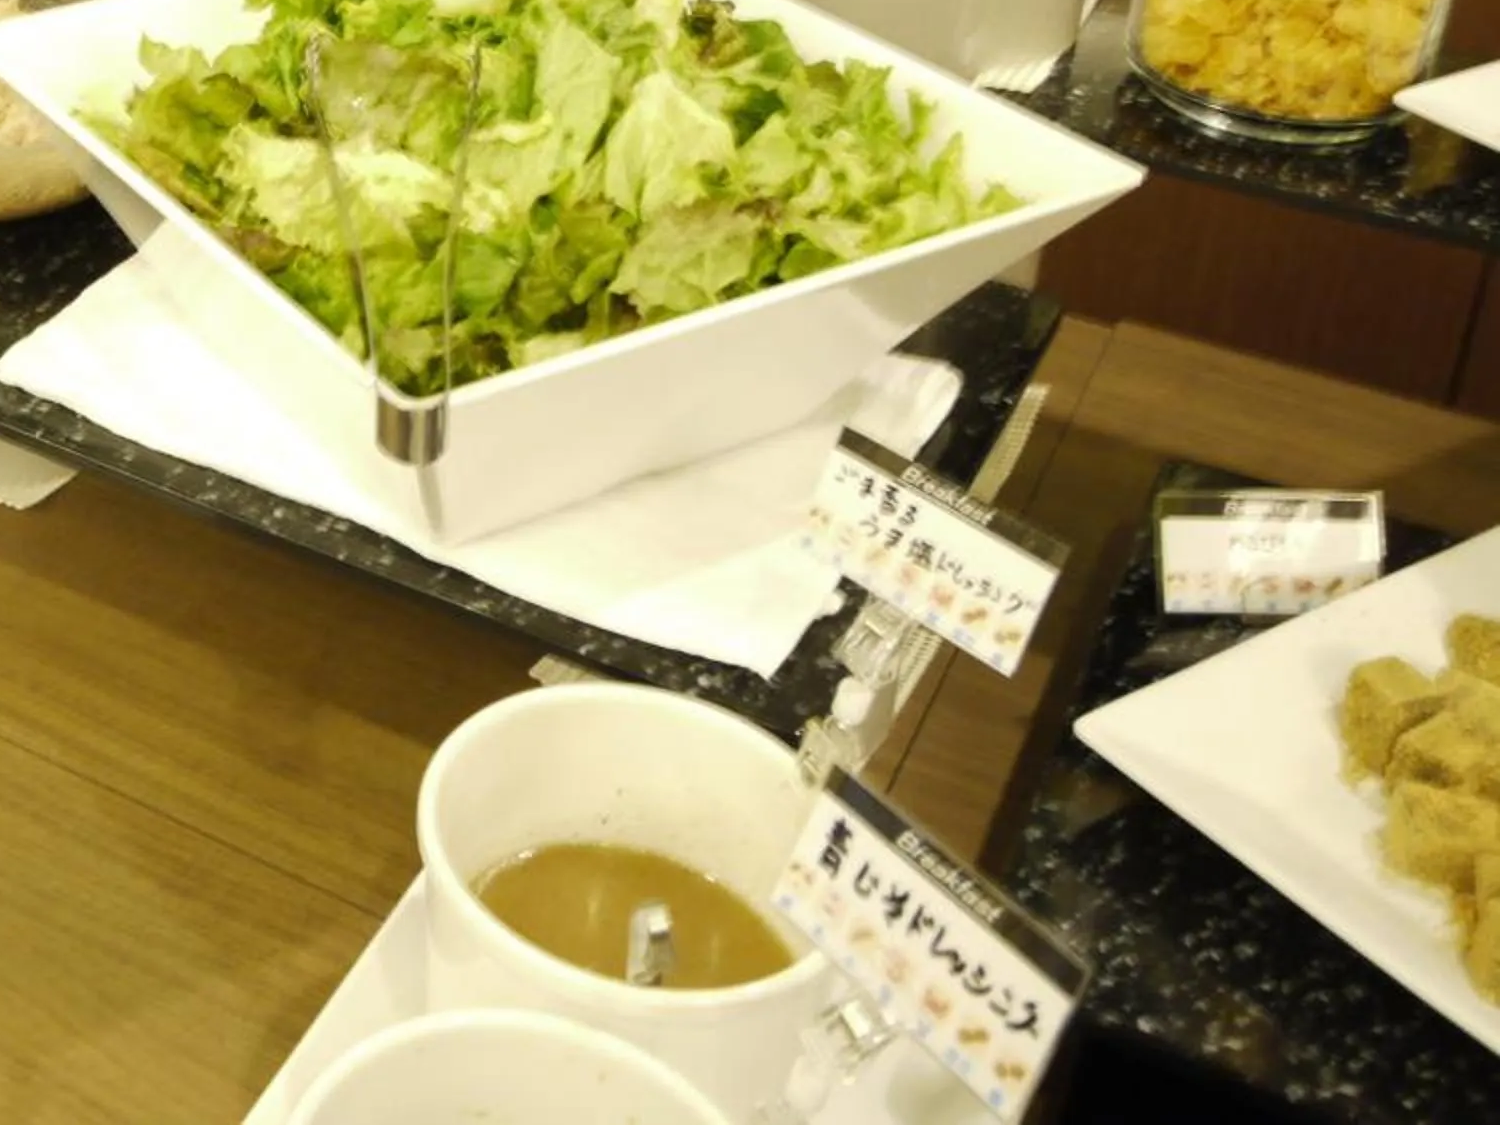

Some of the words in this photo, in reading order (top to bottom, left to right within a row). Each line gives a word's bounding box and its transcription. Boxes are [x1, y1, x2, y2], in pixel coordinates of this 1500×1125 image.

[833, 463, 920, 528] ごま香る
[899, 461, 1000, 527] Breakfast
[894, 829, 1005, 925] Breakfast
